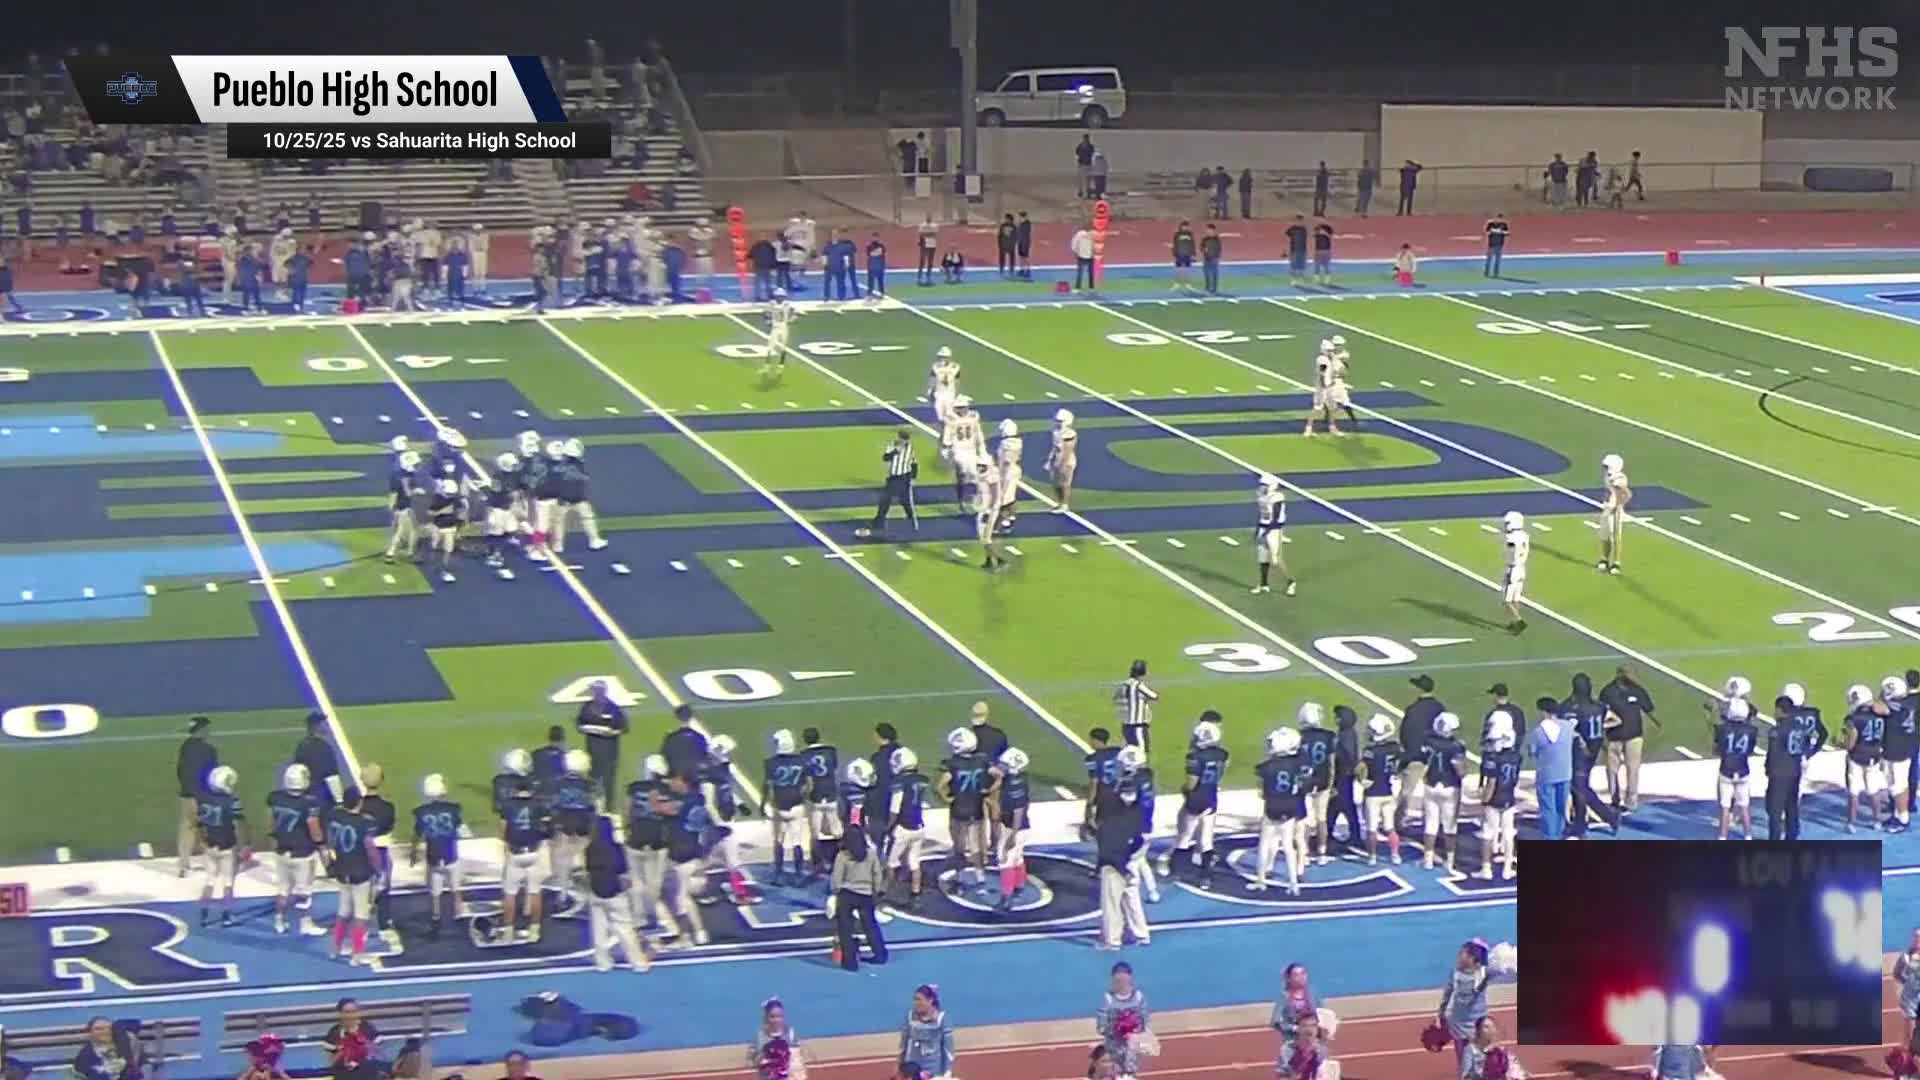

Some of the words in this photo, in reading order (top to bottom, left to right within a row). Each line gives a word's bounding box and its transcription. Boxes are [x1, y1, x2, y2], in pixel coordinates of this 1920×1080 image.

[1183, 635, 1418, 672] 30
[1588, 716, 1605, 739] 11
[1726, 733, 1749, 754] 14
[776, 765, 804, 787] 27
